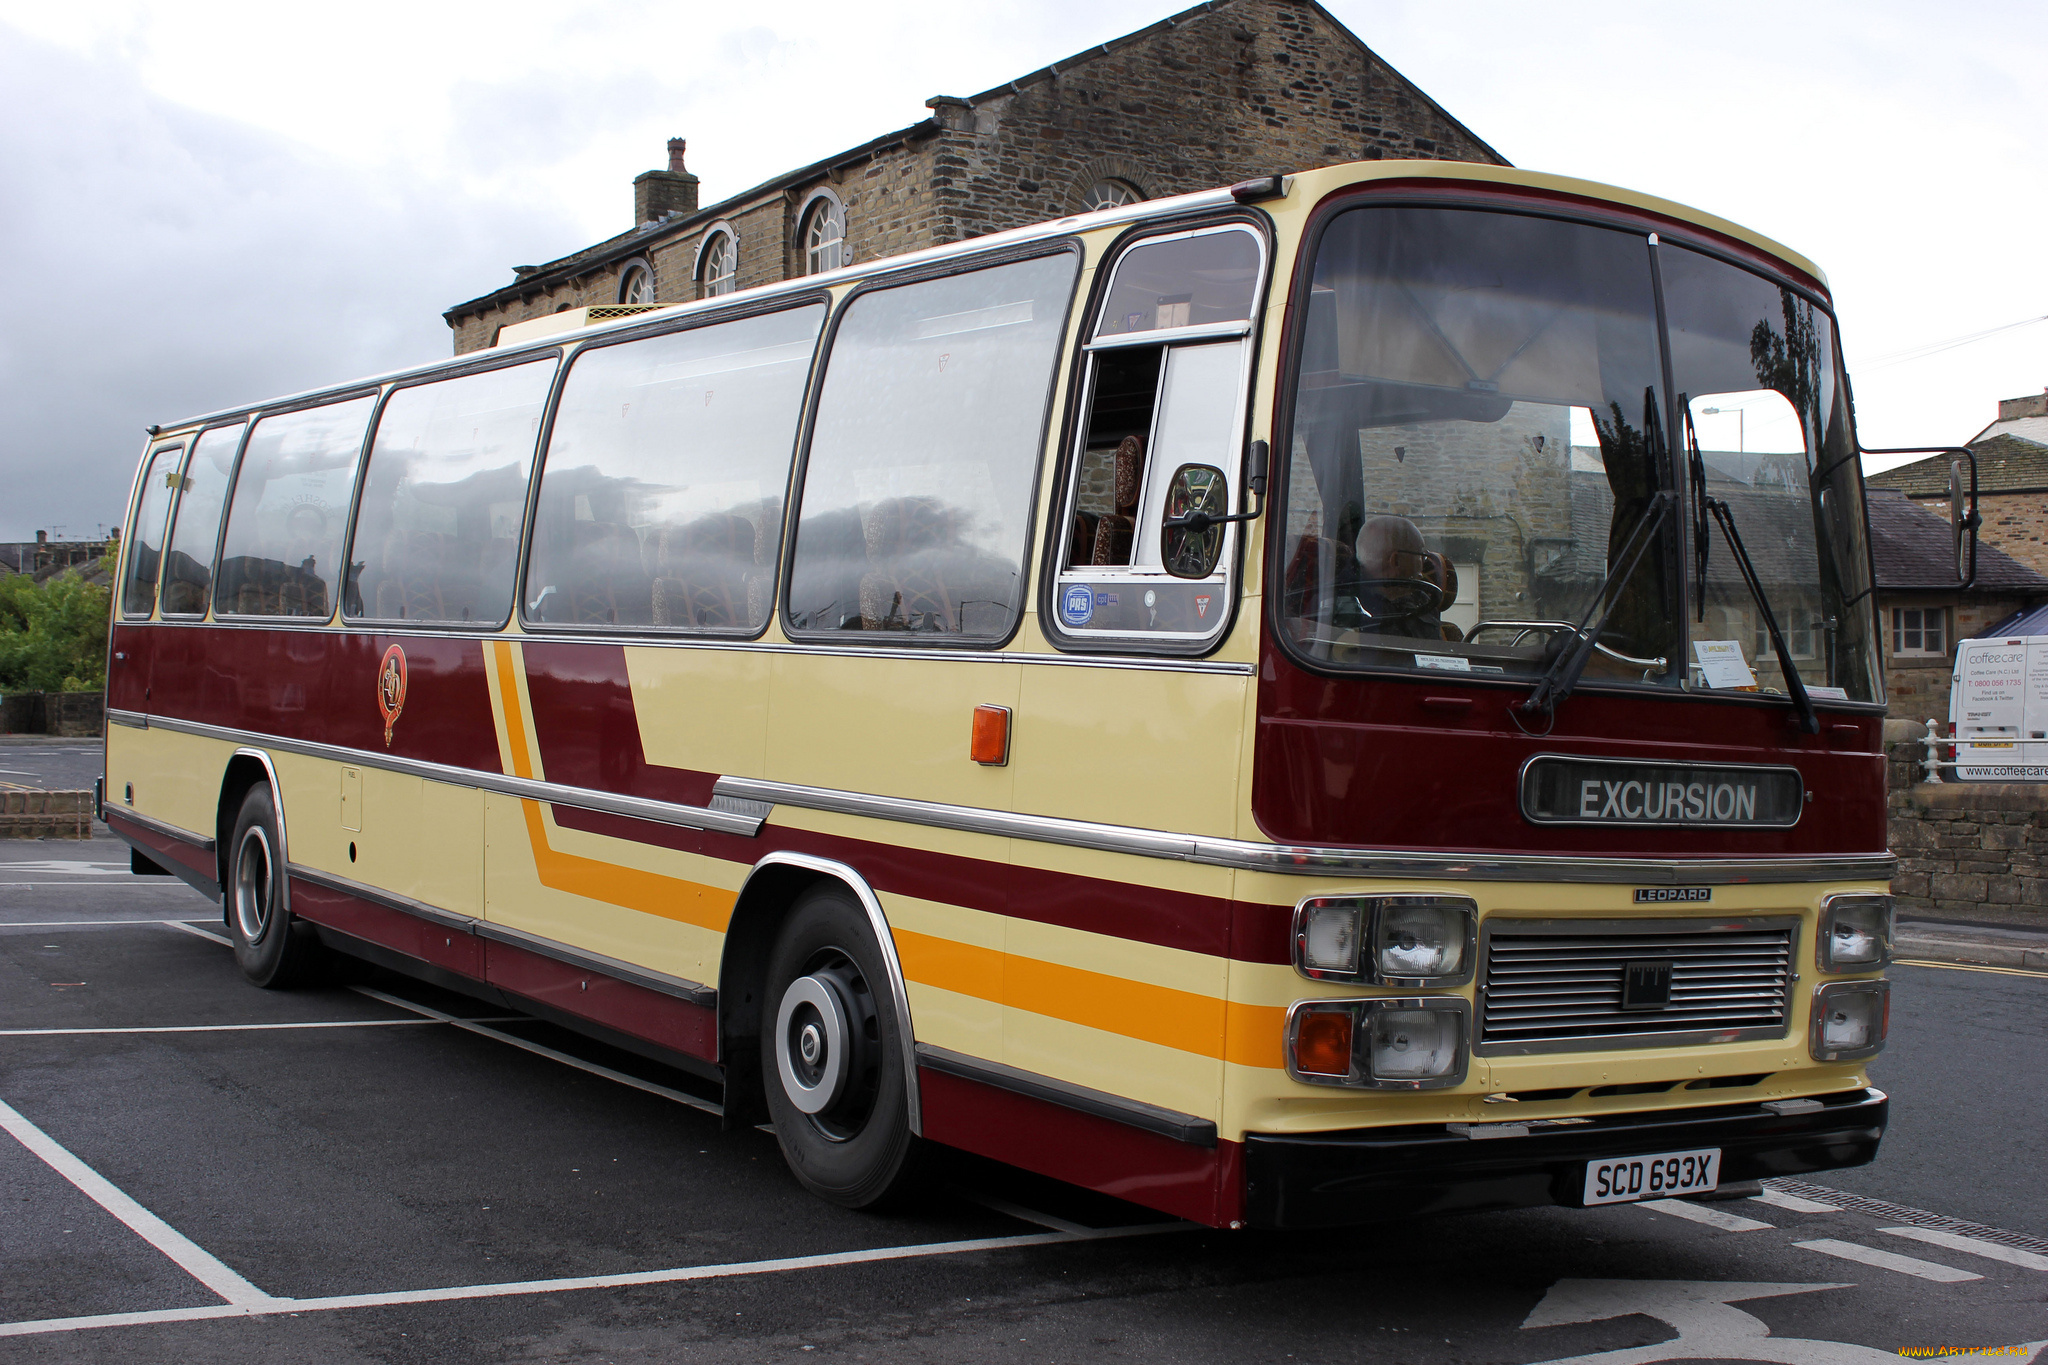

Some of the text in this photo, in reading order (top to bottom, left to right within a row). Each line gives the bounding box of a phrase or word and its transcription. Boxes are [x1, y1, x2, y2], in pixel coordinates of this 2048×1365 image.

[1580, 780, 1756, 820] EXCURSION
[1639, 889, 1708, 901] LEOPARD
[1595, 1155, 1711, 1198] SCD 693X
